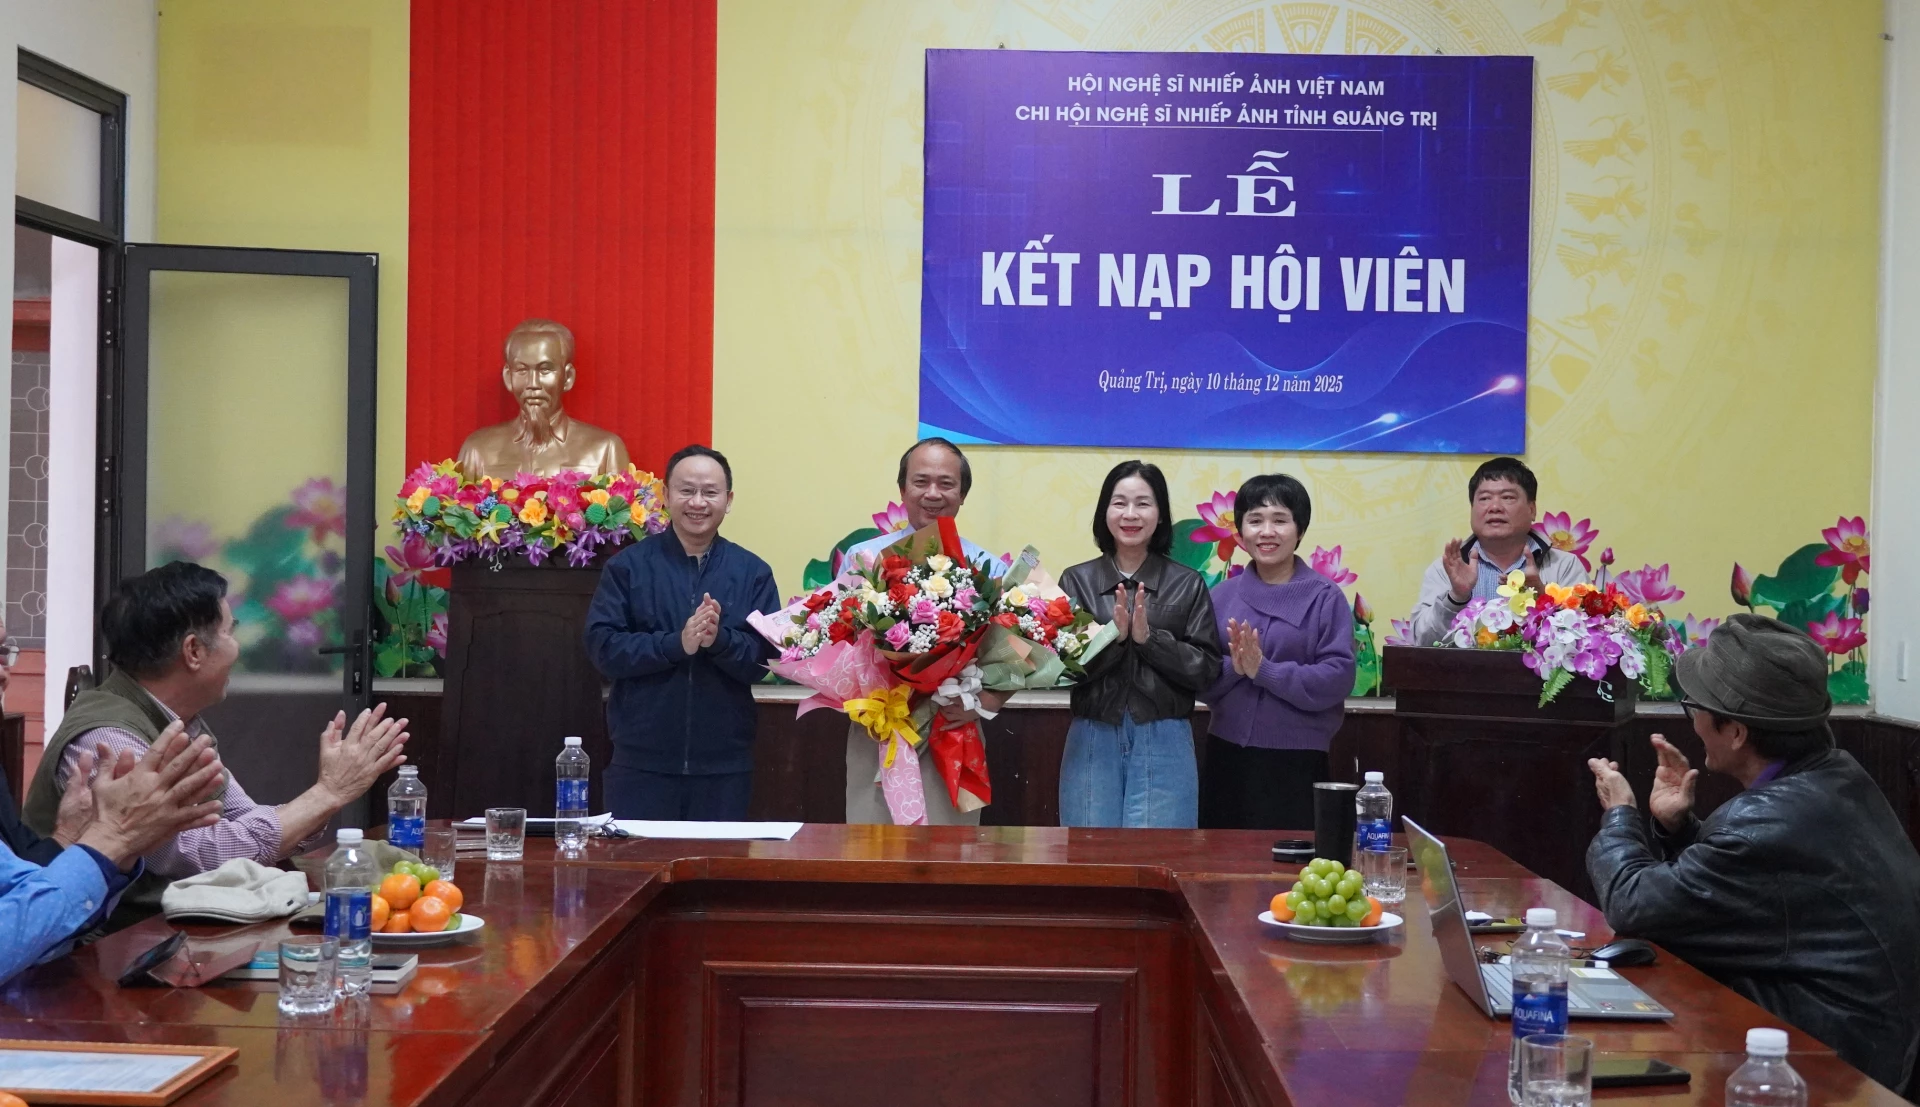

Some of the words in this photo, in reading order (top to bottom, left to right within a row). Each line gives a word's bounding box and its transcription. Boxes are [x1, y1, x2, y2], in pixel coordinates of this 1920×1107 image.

[1068, 73, 1103, 96] HỘI
[1108, 73, 1161, 97] NGHỆ
[1166, 74, 1185, 93] SĨ
[1189, 71, 1244, 93] NHIẾP
[1249, 73, 1291, 95] ẢNH
[1296, 76, 1335, 99] VIỆT
[1340, 81, 1385, 96] NAM
[1015, 105, 1050, 121] CHI
[1056, 102, 1091, 126] HỘI
[1096, 103, 1149, 127] NGHỆ
[1154, 103, 1173, 123] SĨ
[1177, 101, 1232, 123] NHIẾP
[1236, 102, 1278, 124] ẢNH
[1283, 104, 1327, 125] TỈNH
[1332, 105, 1405, 127] QUẢNG
[1410, 111, 1438, 131] TRỊ
[1151, 150, 1298, 217] LỄ
[981, 233, 1081, 307] KẾT
[1098, 252, 1211, 321] NẠP
[1230, 243, 1321, 323] HỘI
[1339, 245, 1466, 313] VIÊN
[1098, 368, 1143, 393] Quảng
[1145, 370, 1168, 394] Trị,
[1171, 371, 1204, 394] ngày
[1206, 372, 1221, 390] 10
[1223, 372, 1262, 395] tháng
[1265, 373, 1280, 391] 12
[1282, 375, 1311, 392] năm
[1313, 374, 1344, 393] 2025
